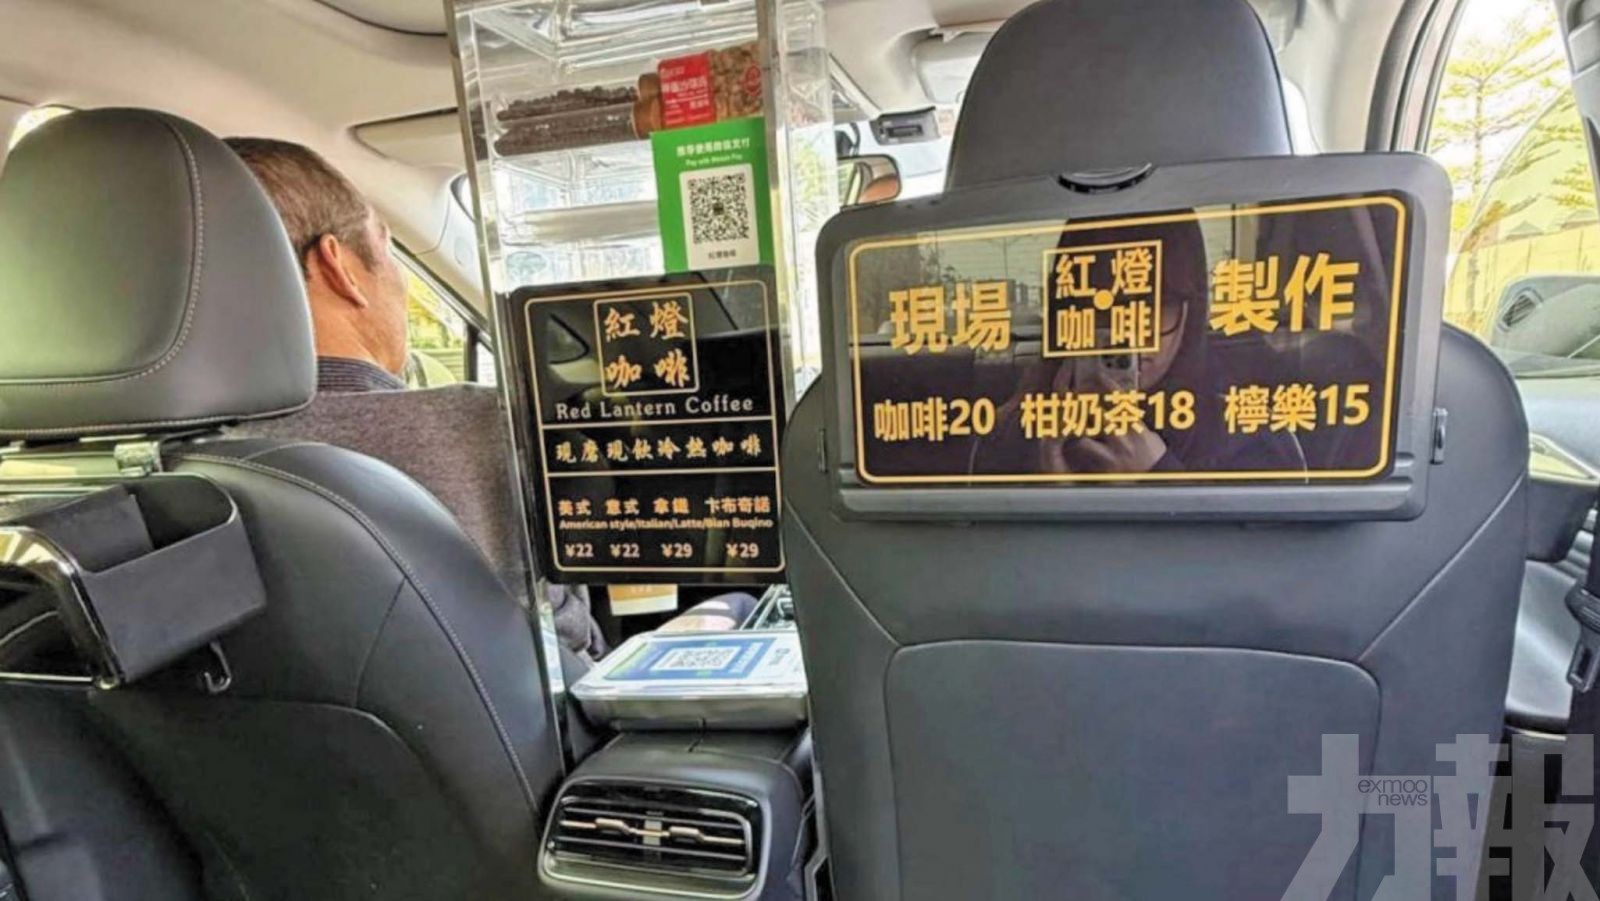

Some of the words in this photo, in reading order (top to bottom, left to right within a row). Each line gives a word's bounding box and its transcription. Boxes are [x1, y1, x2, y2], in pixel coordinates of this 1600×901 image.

[1055, 248, 1154, 299] 紅燈
[604, 301, 689, 342] 紅燈
[889, 281, 1012, 355] 現場
[1209, 253, 1360, 336] 製作
[1056, 301, 1152, 350] 咖啡
[605, 348, 690, 389] 咖啡
[556, 402, 592, 420] Red
[600, 399, 676, 418] Lantern
[685, 395, 754, 414] Coffee
[873, 398, 996, 443] 咖啡20
[1020, 391, 1196, 439] 柑奶茶18
[1224, 384, 1371, 435] 檸樂15
[559, 520, 608, 530] American
[565, 543, 594, 558] ¥22
[610, 543, 640, 558] ¥22
[661, 543, 693, 558] ¥29
[726, 543, 760, 558] ¥29
